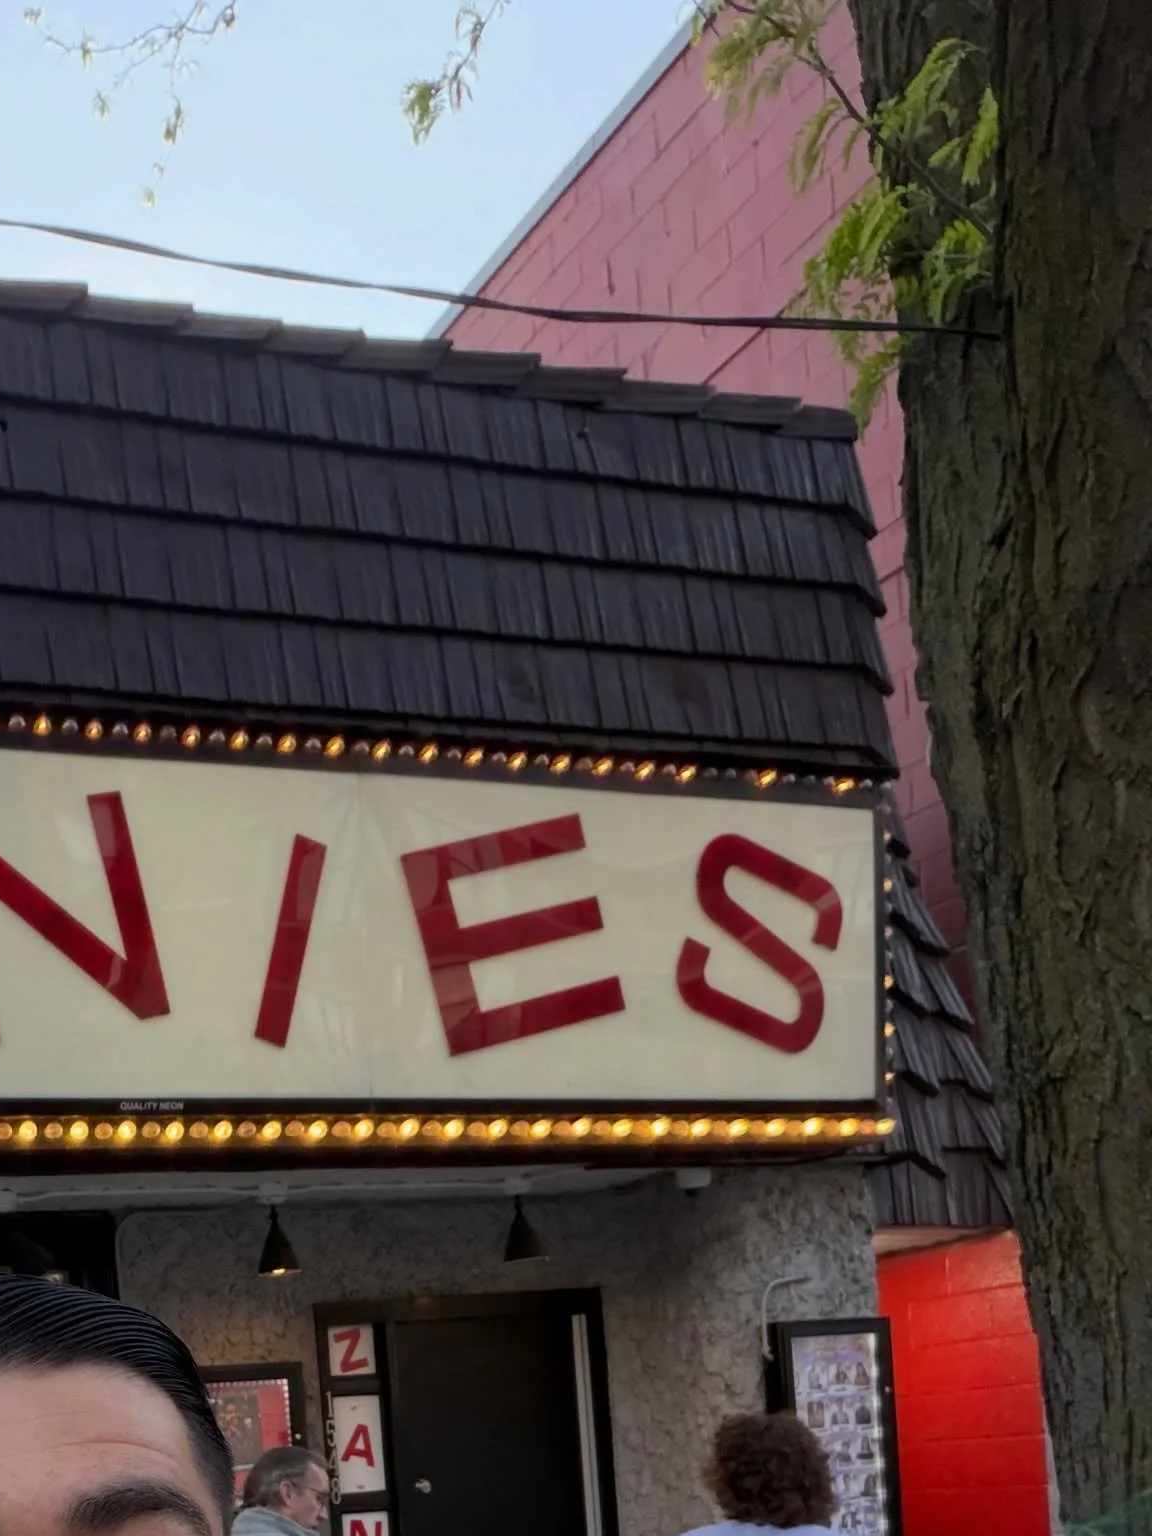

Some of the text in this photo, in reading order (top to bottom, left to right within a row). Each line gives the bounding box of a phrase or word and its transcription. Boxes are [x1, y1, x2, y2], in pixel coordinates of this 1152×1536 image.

[119, 1101, 184, 1111] QUALITY NEON
[326, 1391, 343, 1505] 1548
